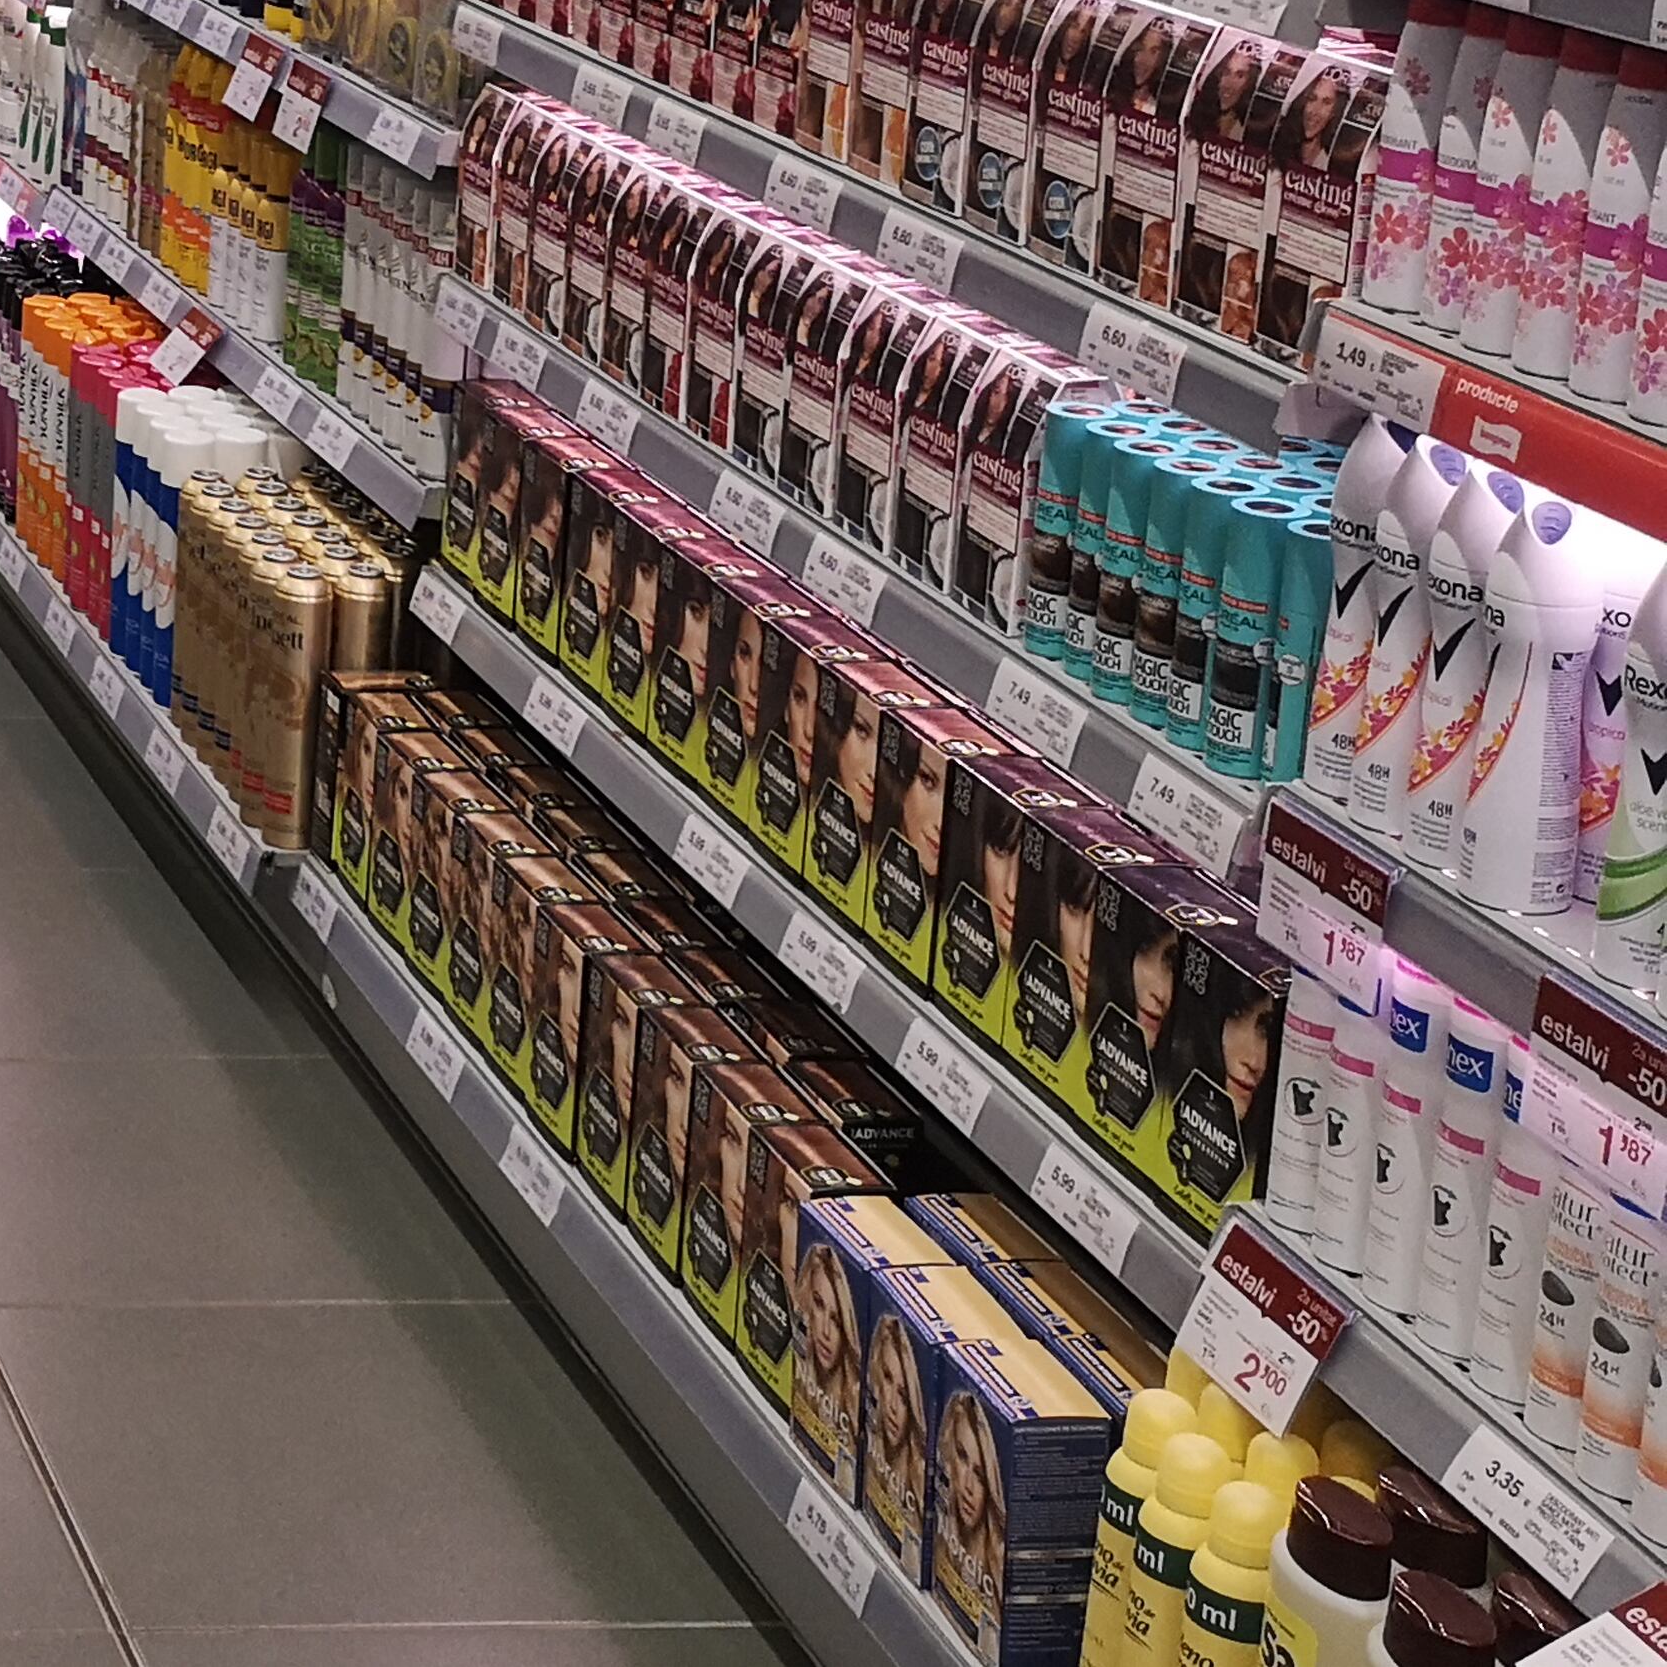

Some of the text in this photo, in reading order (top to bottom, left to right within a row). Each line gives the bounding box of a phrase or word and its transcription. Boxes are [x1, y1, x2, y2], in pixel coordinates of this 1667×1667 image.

[866, 20, 909, 53] casting
[923, 39, 968, 74] casting
[983, 62, 1030, 99] casting
[1048, 87, 1101, 128] casting
[1119, 111, 1177, 156] casting
[1202, 140, 1266, 184] casting
[1284, 169, 1352, 216] casting
[1101, 325, 1127, 349] 6,60
[1337, 341, 1366, 368] 1,49
[851, 383, 893, 415] casting
[1456, 379, 1518, 414] producte
[911, 415, 955, 450] casting
[973, 448, 1021, 486] casting
[1028, 591, 1057, 613] AGIC
[1008, 681, 1030, 704] 7,49
[1210, 706, 1242, 730] AGIC
[1368, 764, 1389, 780] 48H
[1149, 778, 1175, 804] 7,49
[1428, 801, 1453, 817] 48H
[1271, 837, 1327, 884] estalvi
[917, 1041, 939, 1067] 5,99
[1540, 1013, 1609, 1072] estalvi
[1449, 1046, 1484, 1079] nex
[1051, 1165, 1076, 1194] 5,99
[1220, 1254, 1278, 1309] estalvi
[1297, 1287, 1311, 1306] 2a
[1540, 1304, 1565, 1327] 24H
[1591, 1353, 1619, 1375] 24H
[1485, 1460, 1525, 1498] 3,35
[1106, 1497, 1134, 1527] ml
[1137, 1542, 1165, 1573] ml
[1202, 1600, 1237, 1632] ml
